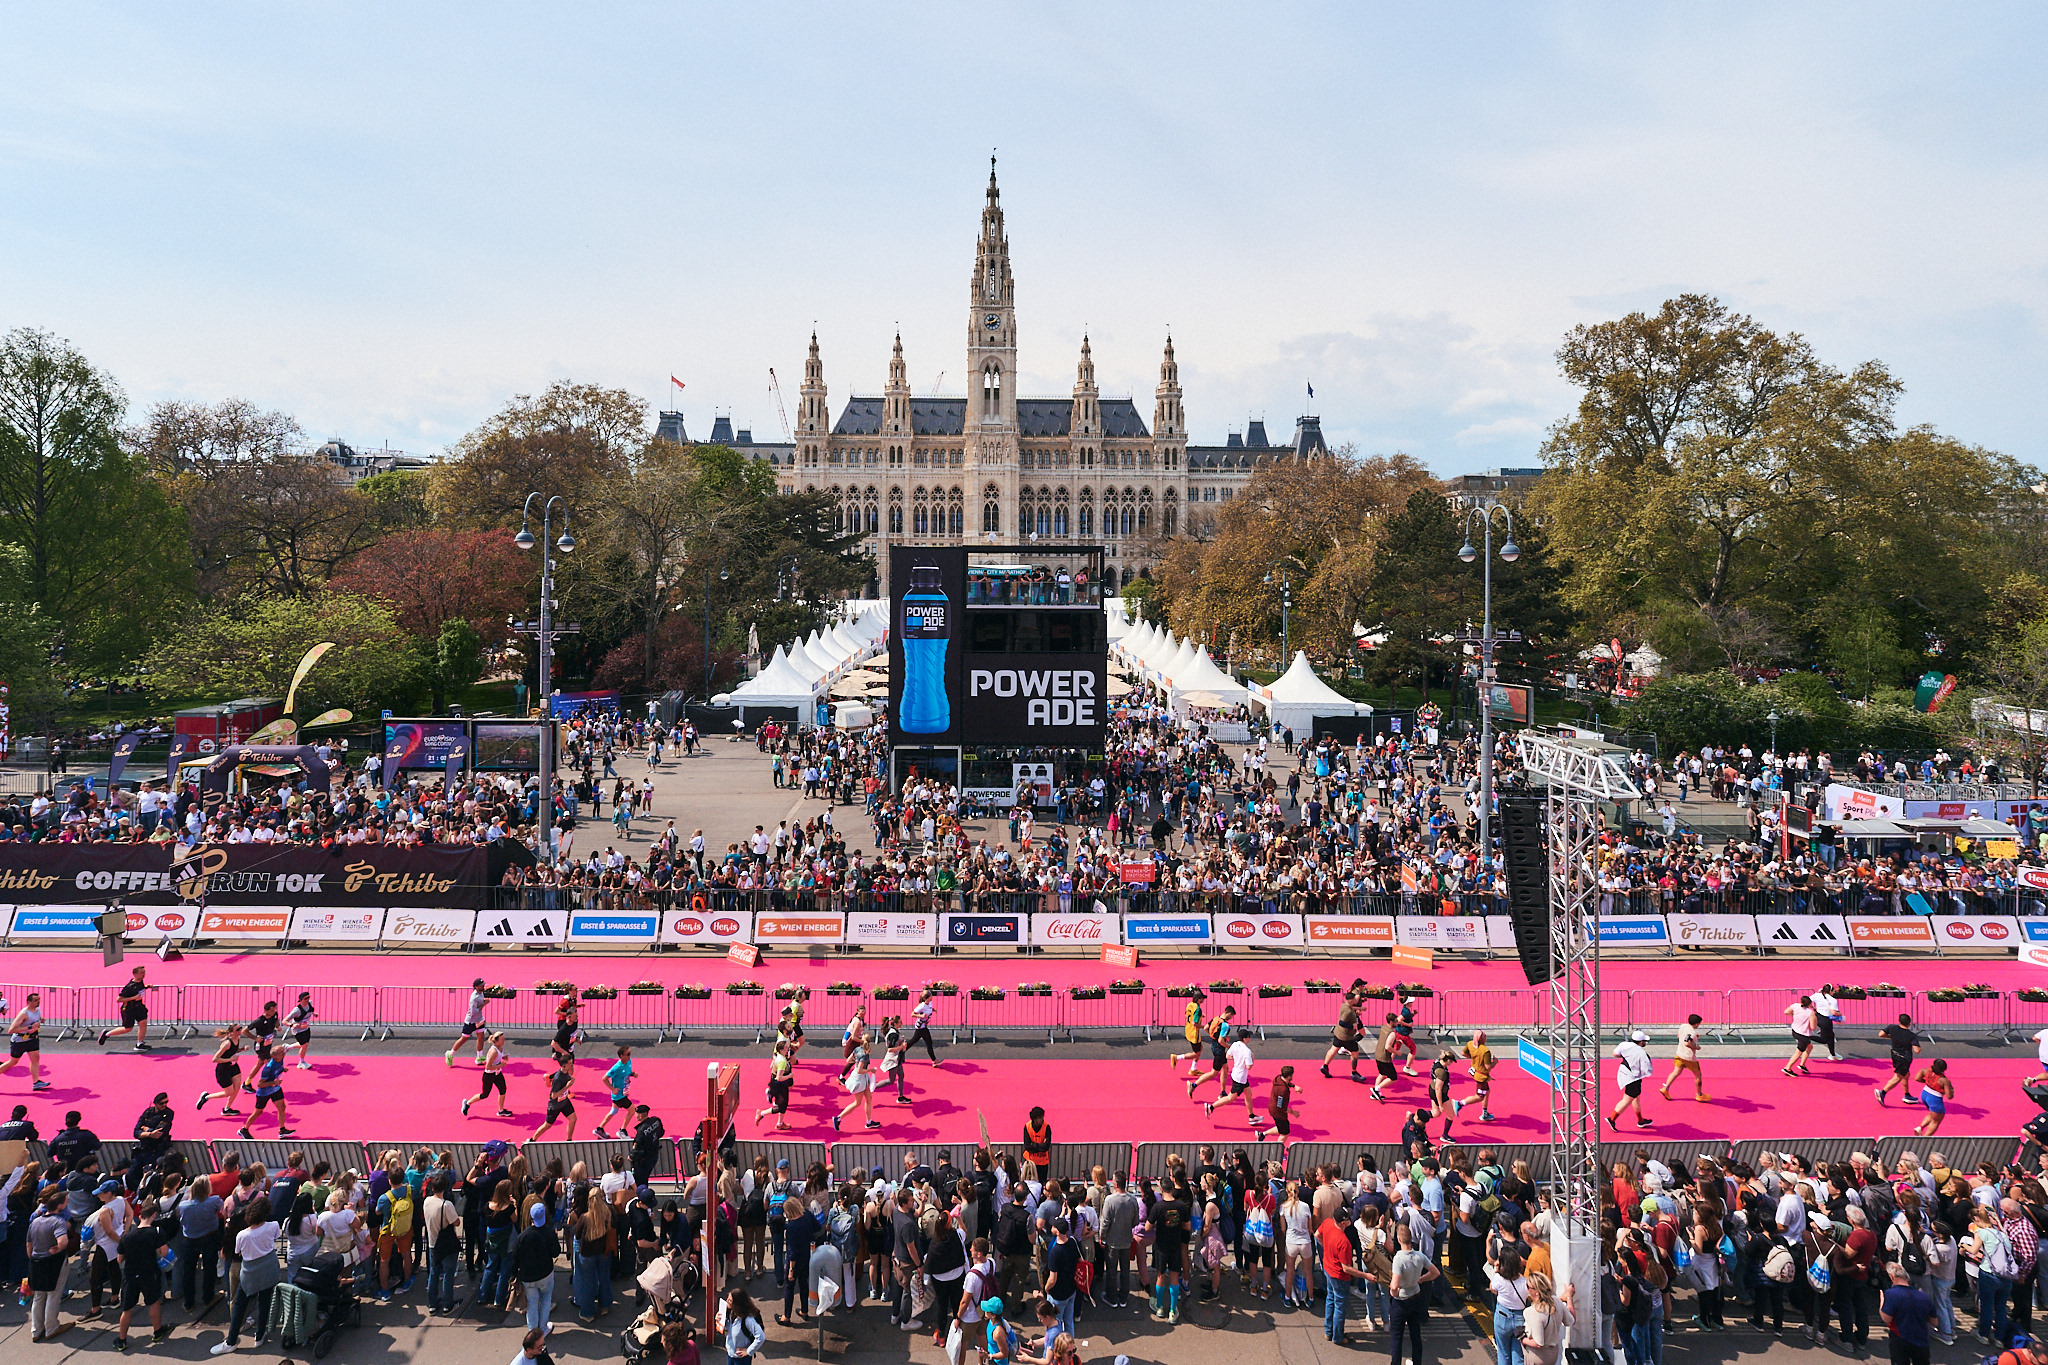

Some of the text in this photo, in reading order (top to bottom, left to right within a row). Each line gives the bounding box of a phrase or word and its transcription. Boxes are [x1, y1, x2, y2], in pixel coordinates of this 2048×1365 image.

[906, 607, 945, 616] POWER
[923, 616, 945, 626] ADE
[970, 670, 1096, 698] POWER
[1027, 698, 1096, 726] ADE
[250, 754, 284, 762] Tchibo
[1857, 794, 1872, 804] Mein
[1843, 803, 1864, 814] Sport
[0, 868, 60, 889] hibo
[212, 872, 270, 892] RUN
[276, 874, 325, 892] 10K
[375, 873, 456, 892] Tchibo
[126, 918, 146, 927] ervis
[158, 918, 183, 928] Hervis
[677, 921, 702, 932] Hervis
[714, 921, 738, 932] Hervis
[413, 924, 462, 936] Tchibo
[1047, 919, 1104, 938] Coca-Cola
[1230, 924, 1254, 934] Hervis
[1265, 924, 1289, 934] Hervis
[1698, 926, 1746, 940] Tchibo
[1948, 926, 1972, 936] Hervis
[1982, 926, 2007, 936] Hervis
